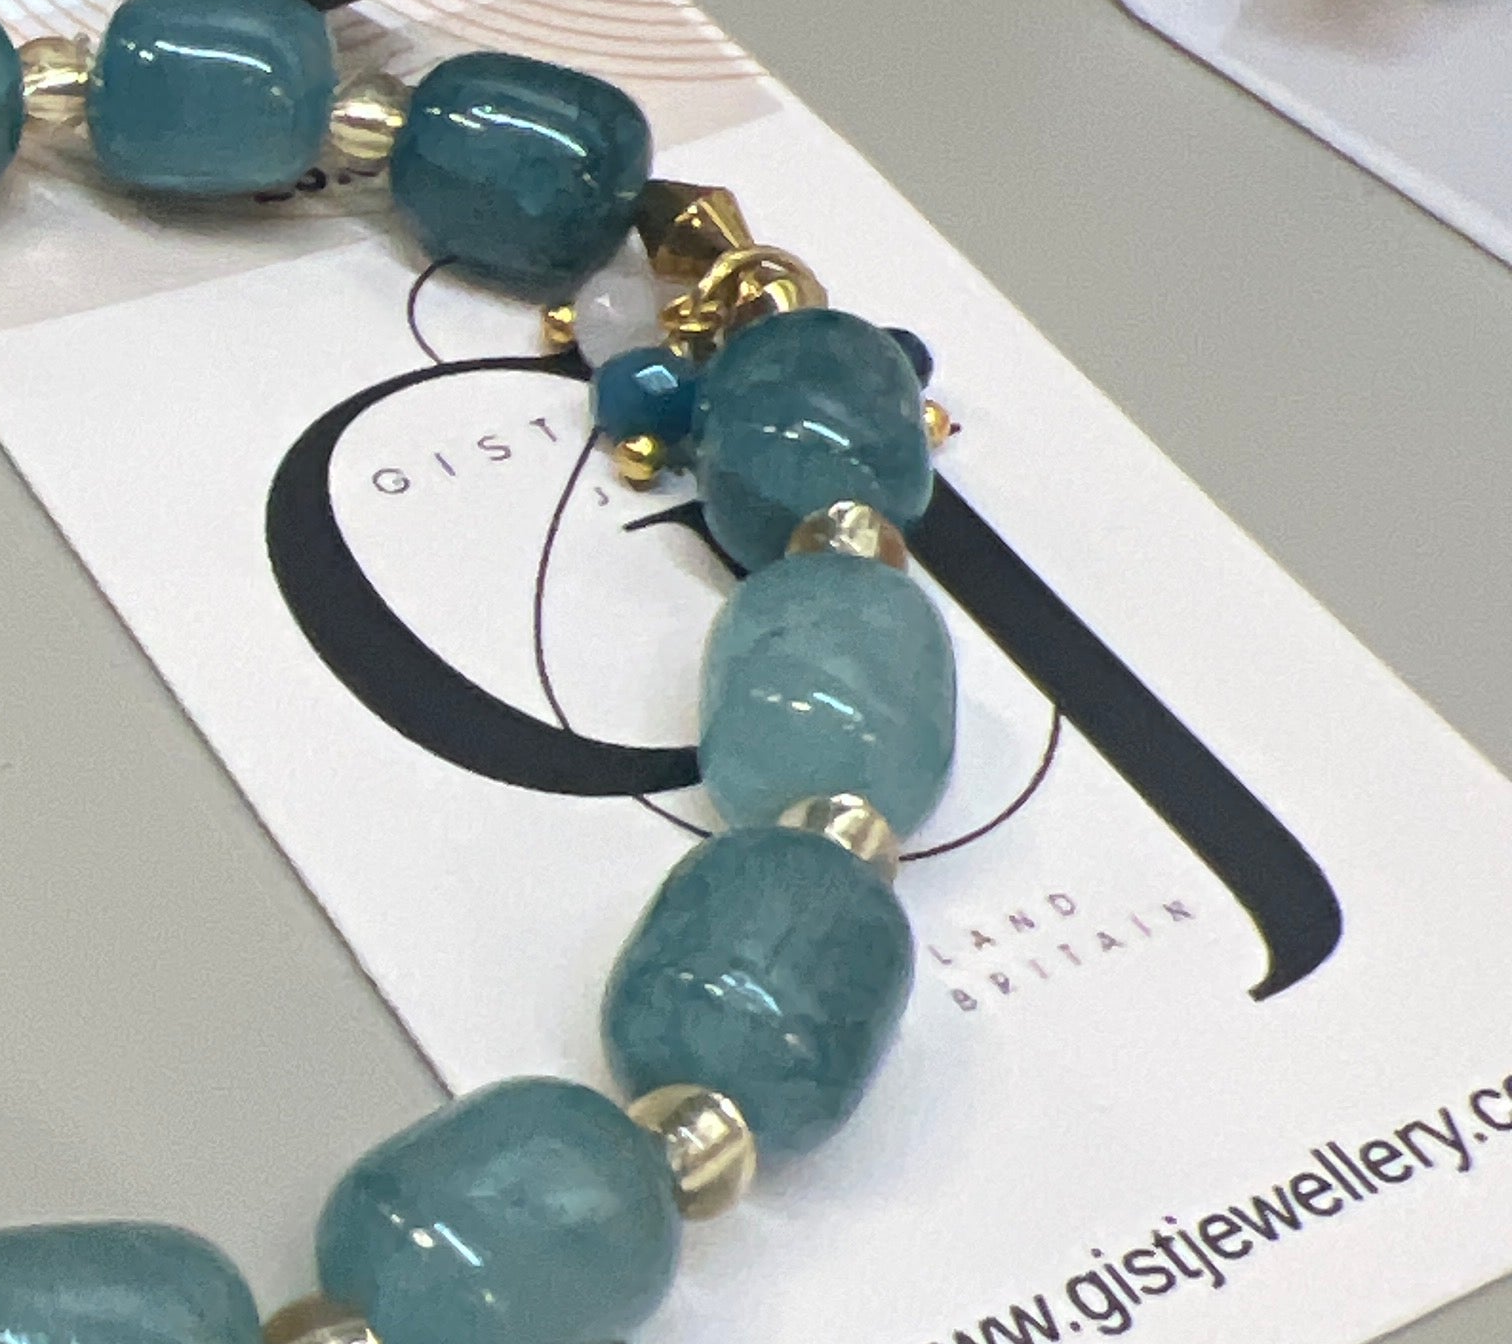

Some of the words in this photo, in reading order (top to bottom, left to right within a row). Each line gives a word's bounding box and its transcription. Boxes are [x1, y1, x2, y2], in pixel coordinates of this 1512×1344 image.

[371, 416, 557, 494] GIST
[927, 892, 1078, 966] LAND
[951, 899, 1195, 1011] BRITAIN
